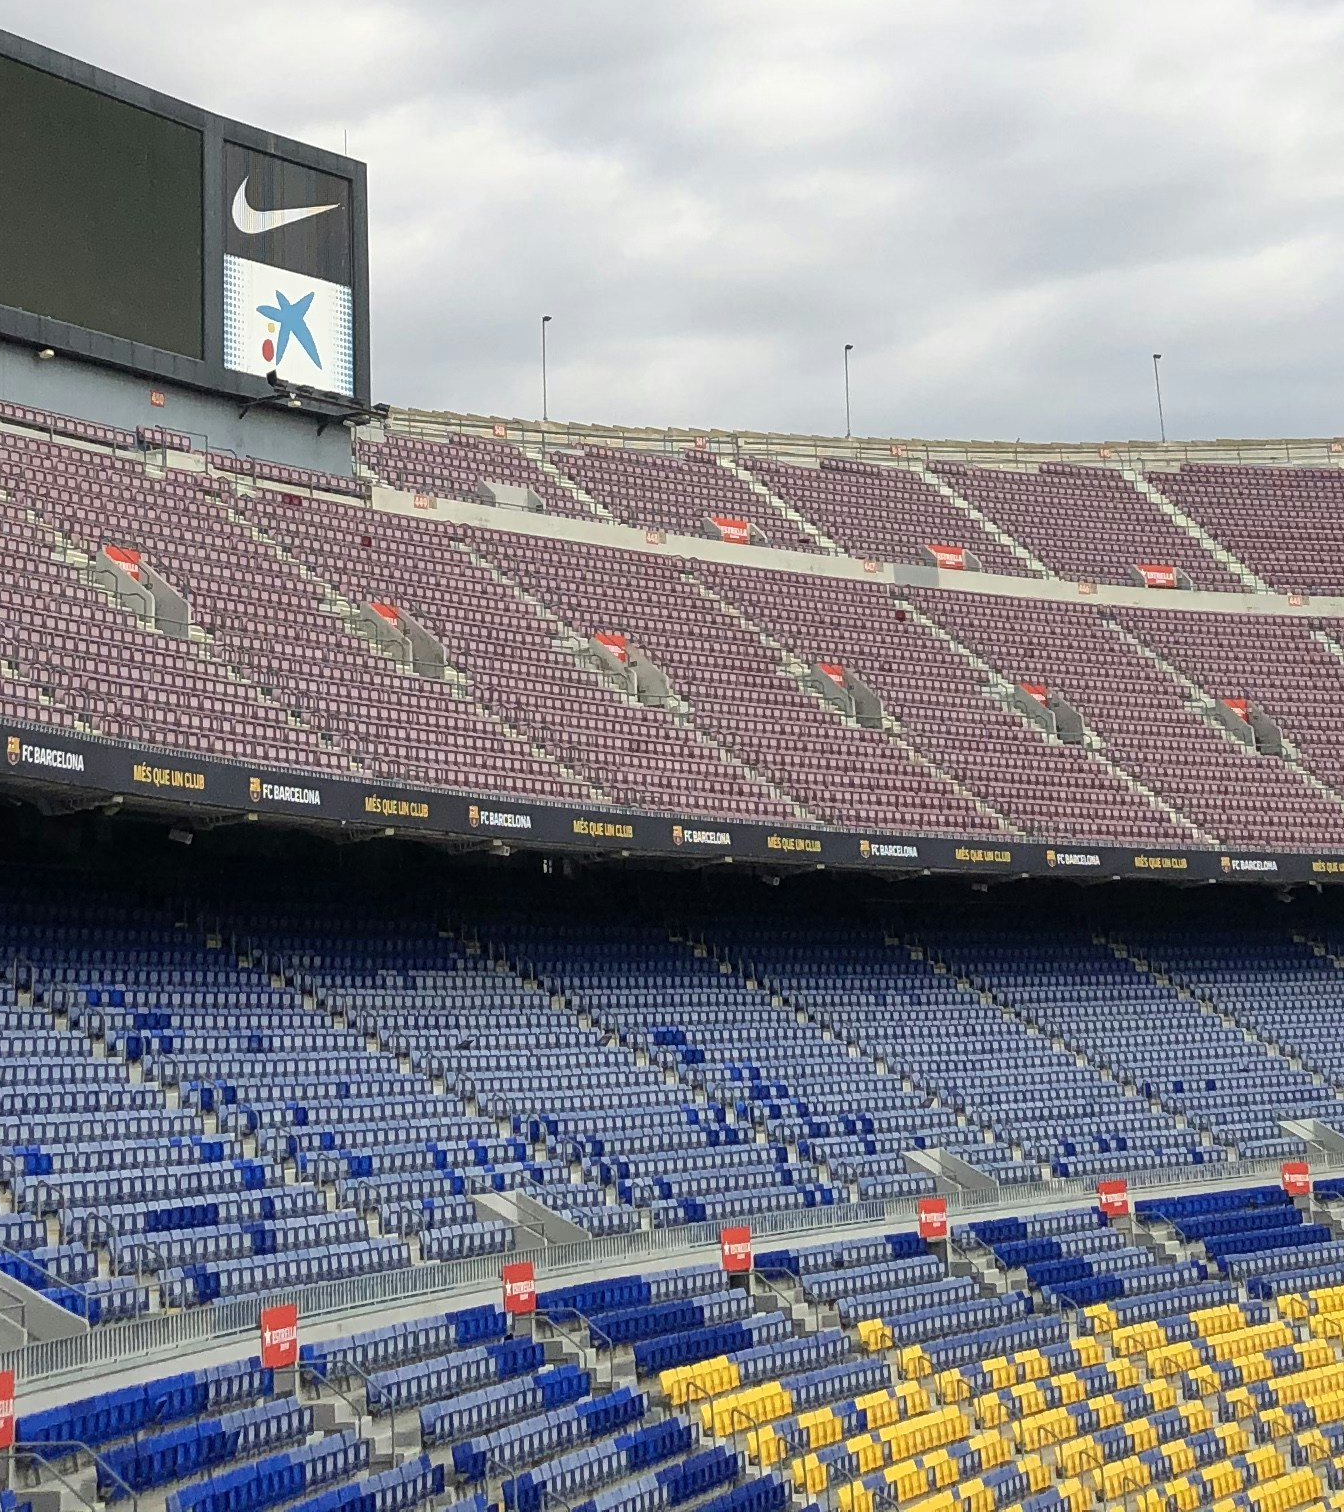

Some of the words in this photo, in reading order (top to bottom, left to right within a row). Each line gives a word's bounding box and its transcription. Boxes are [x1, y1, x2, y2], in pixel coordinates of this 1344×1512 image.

[22, 744, 34, 762] FC
[34, 747, 84, 772] BARCELONA
[153, 767, 170, 788] QUE
[171, 770, 183, 787] UN
[184, 772, 205, 790] CLUB
[262, 783, 273, 800] FC
[273, 785, 321, 806] BARCELONA
[480, 809, 489, 826] FC
[489, 812, 531, 829] BARCELONA
[684, 829, 693, 843] FC
[693, 831, 731, 846] BARCELONA
[871, 843, 879, 856] FC
[879, 845, 918, 858] BARCELONA
